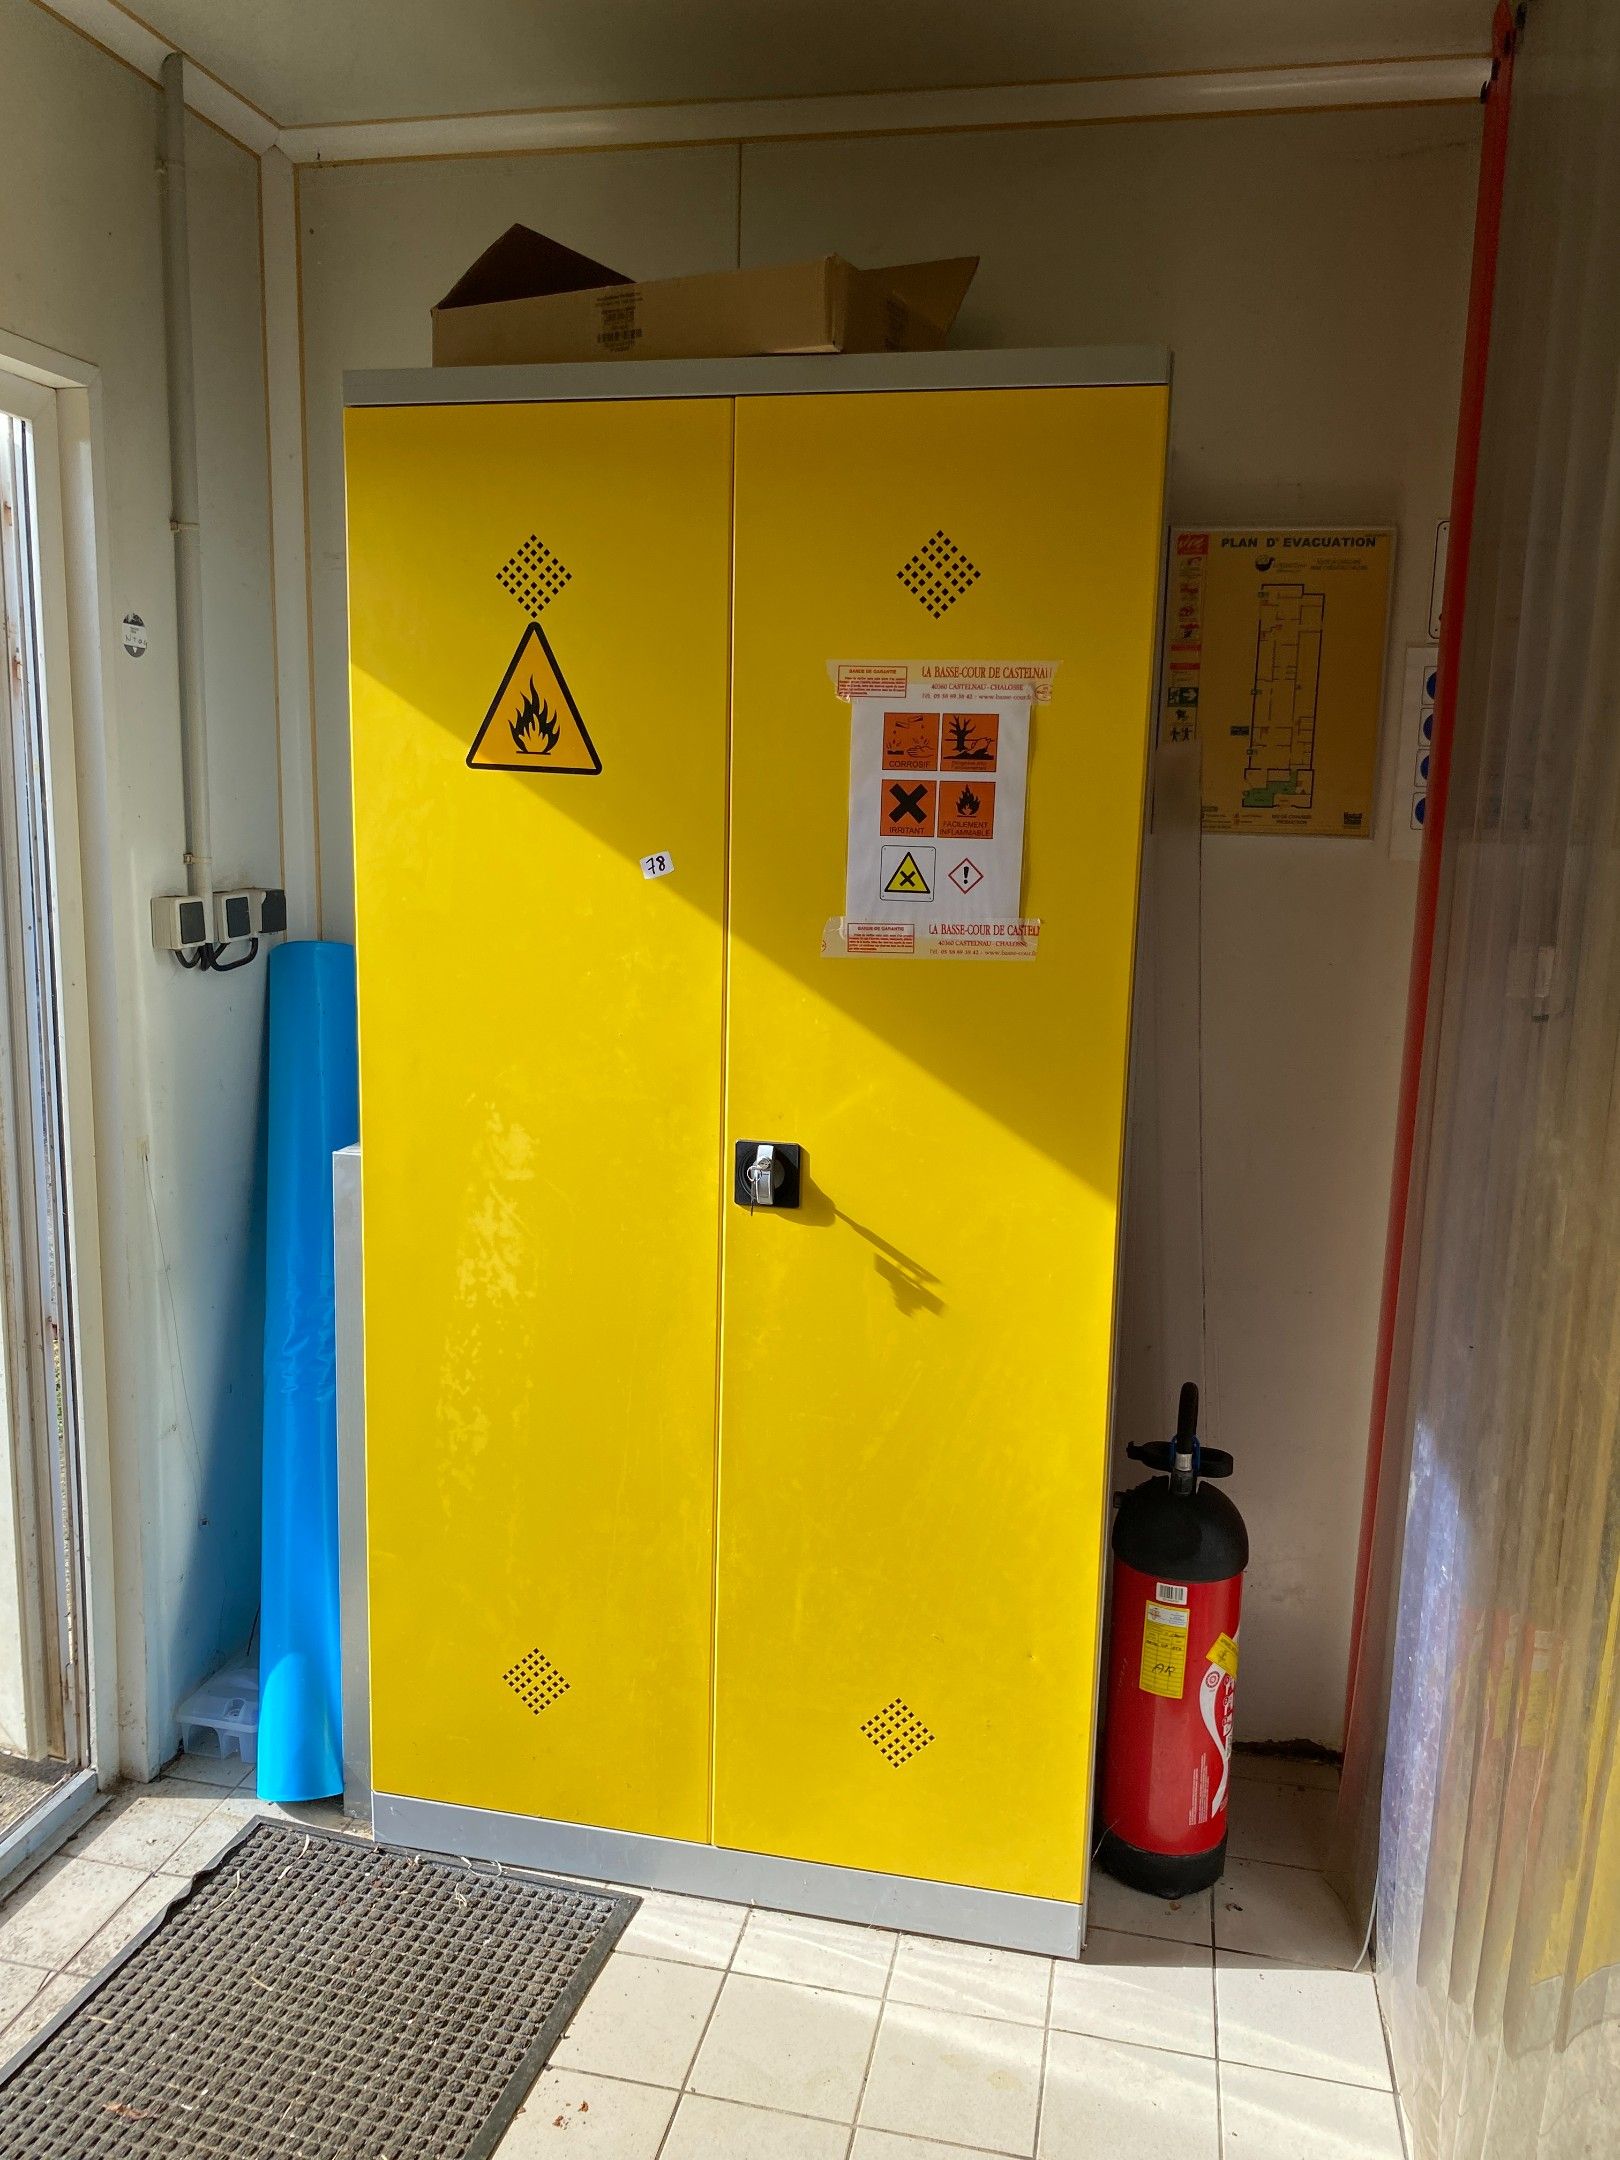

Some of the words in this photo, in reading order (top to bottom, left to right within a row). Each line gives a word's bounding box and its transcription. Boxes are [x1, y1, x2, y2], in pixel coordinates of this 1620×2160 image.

[1221, 538, 1258, 547] PLAN
[921, 666, 931, 677] LA
[935, 666, 986, 678] BASSE-COUR
[988, 666, 1000, 678] DE
[889, 760, 929, 769] CORROSIF
[942, 821, 988, 829] FACILEMENT
[940, 829, 991, 837] INFLAMMABLE
[645, 855, 666, 875] 78
[929, 924, 938, 934] LA
[941, 924, 991, 935] BASSE-COUR
[993, 924, 1004, 935] DE
